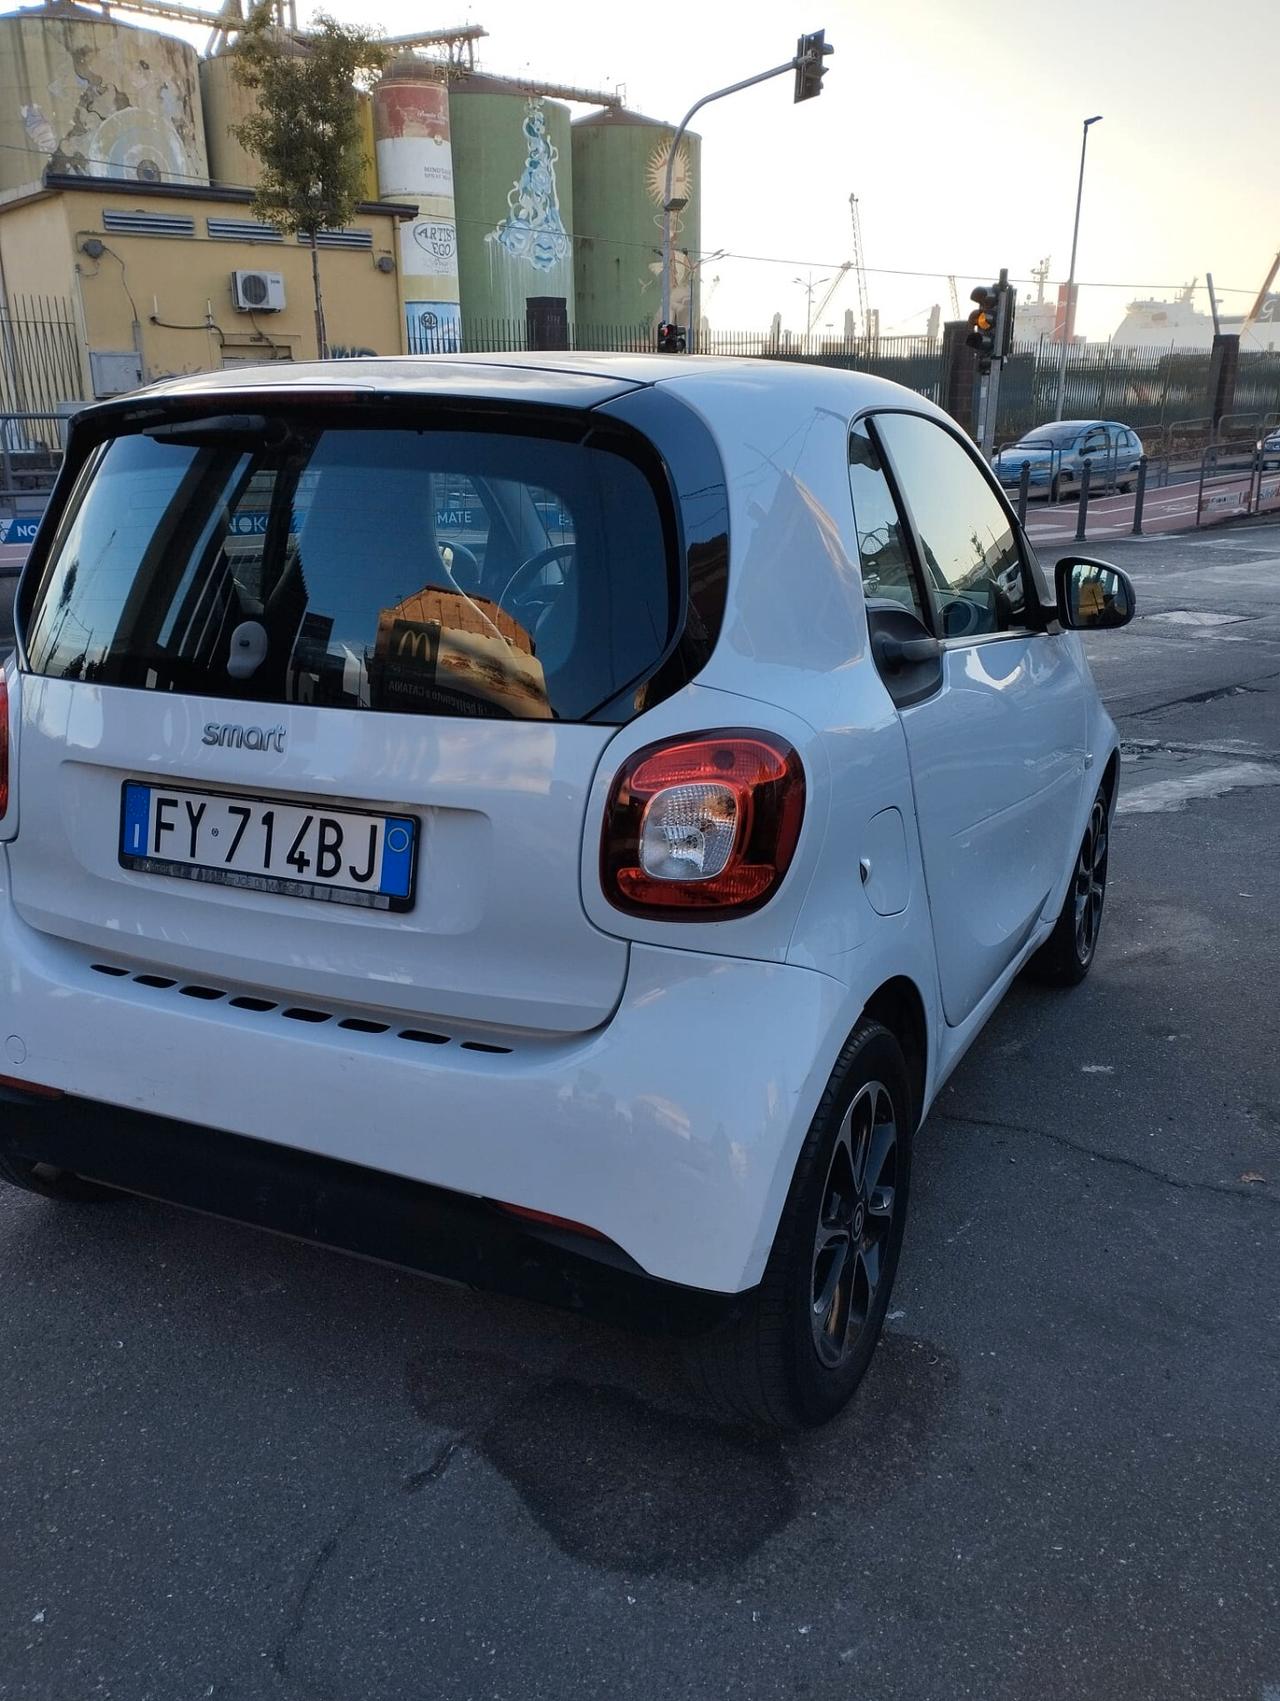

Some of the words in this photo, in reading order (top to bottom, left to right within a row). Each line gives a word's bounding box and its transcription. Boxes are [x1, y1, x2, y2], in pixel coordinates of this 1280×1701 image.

[417, 226, 456, 242] ARTIST
[432, 242, 451, 257] EGO
[436, 510, 472, 524] MATE
[201, 721, 287, 753] smart
